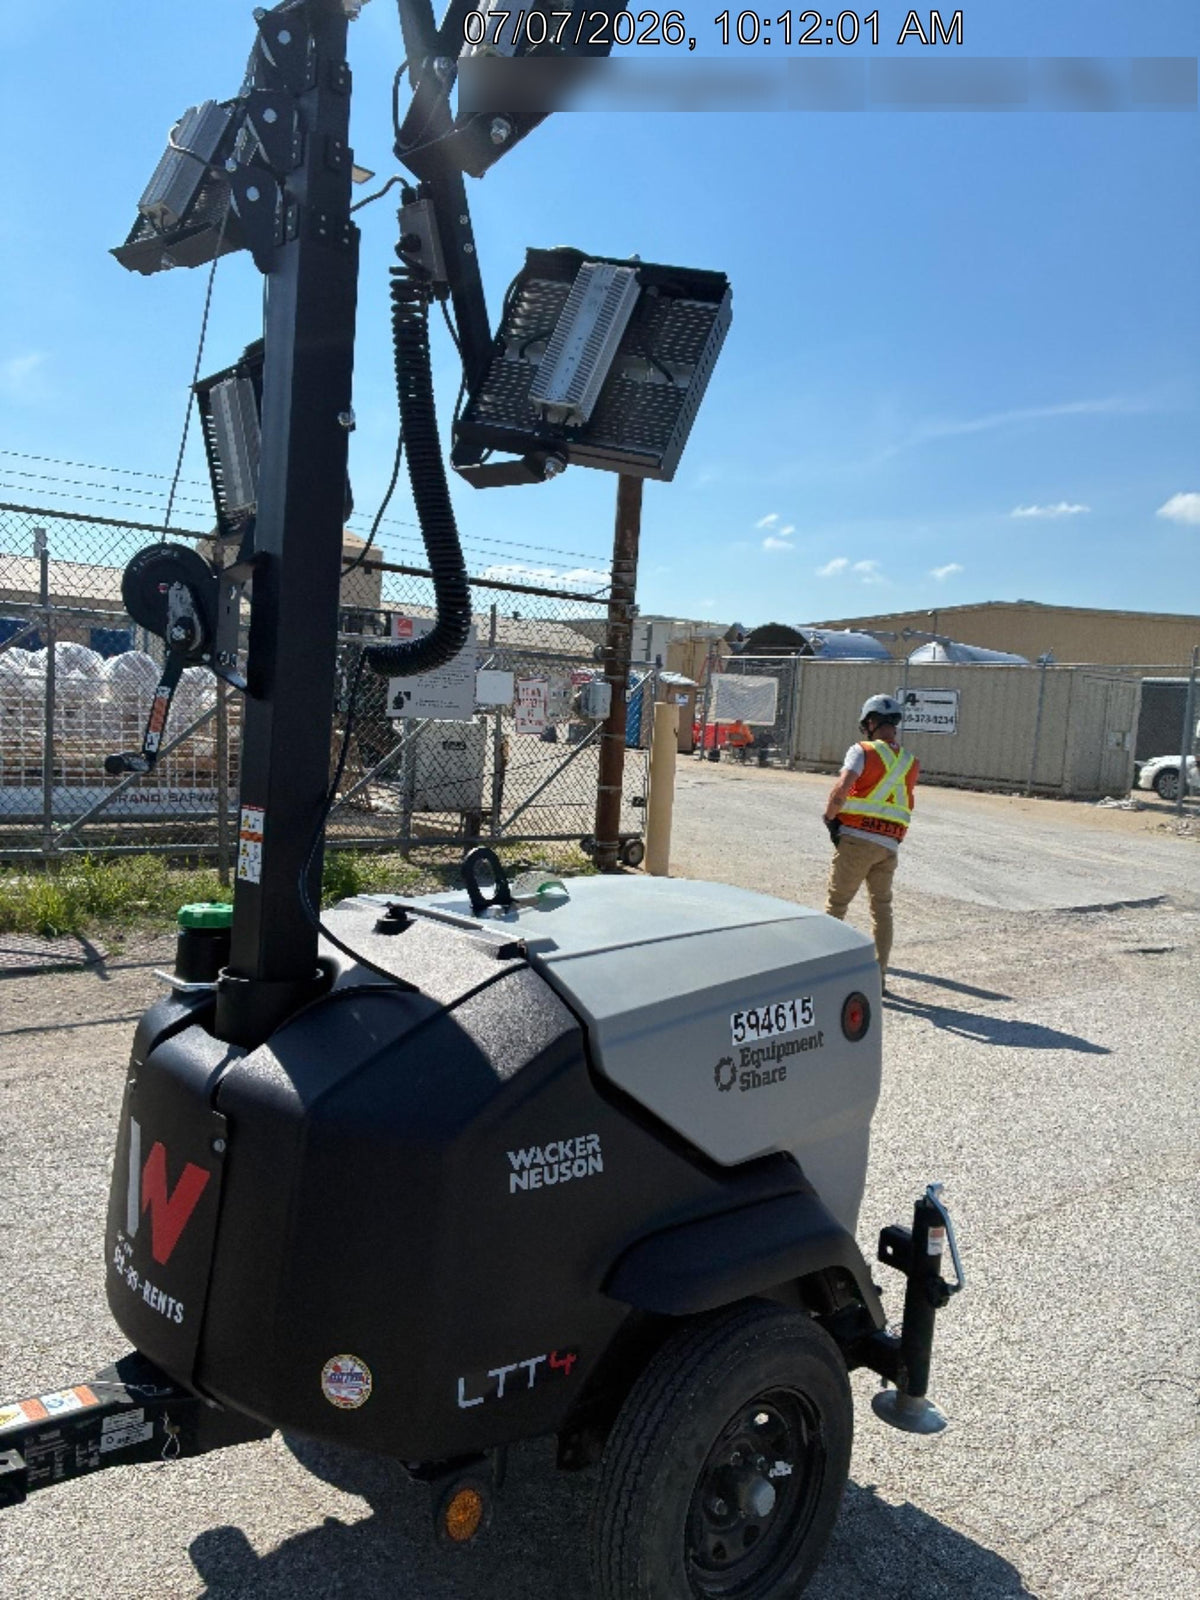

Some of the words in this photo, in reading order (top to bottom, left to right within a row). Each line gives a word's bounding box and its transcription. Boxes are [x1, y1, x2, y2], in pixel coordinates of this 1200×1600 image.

[733, 998, 813, 1042] 594615
[740, 1030, 824, 1069] Equipment
[740, 1066, 787, 1092] Share
[506, 1133, 602, 1171] WACKER
[509, 1153, 604, 1194] NEUSON
[458, 1350, 577, 1409] LTT4
